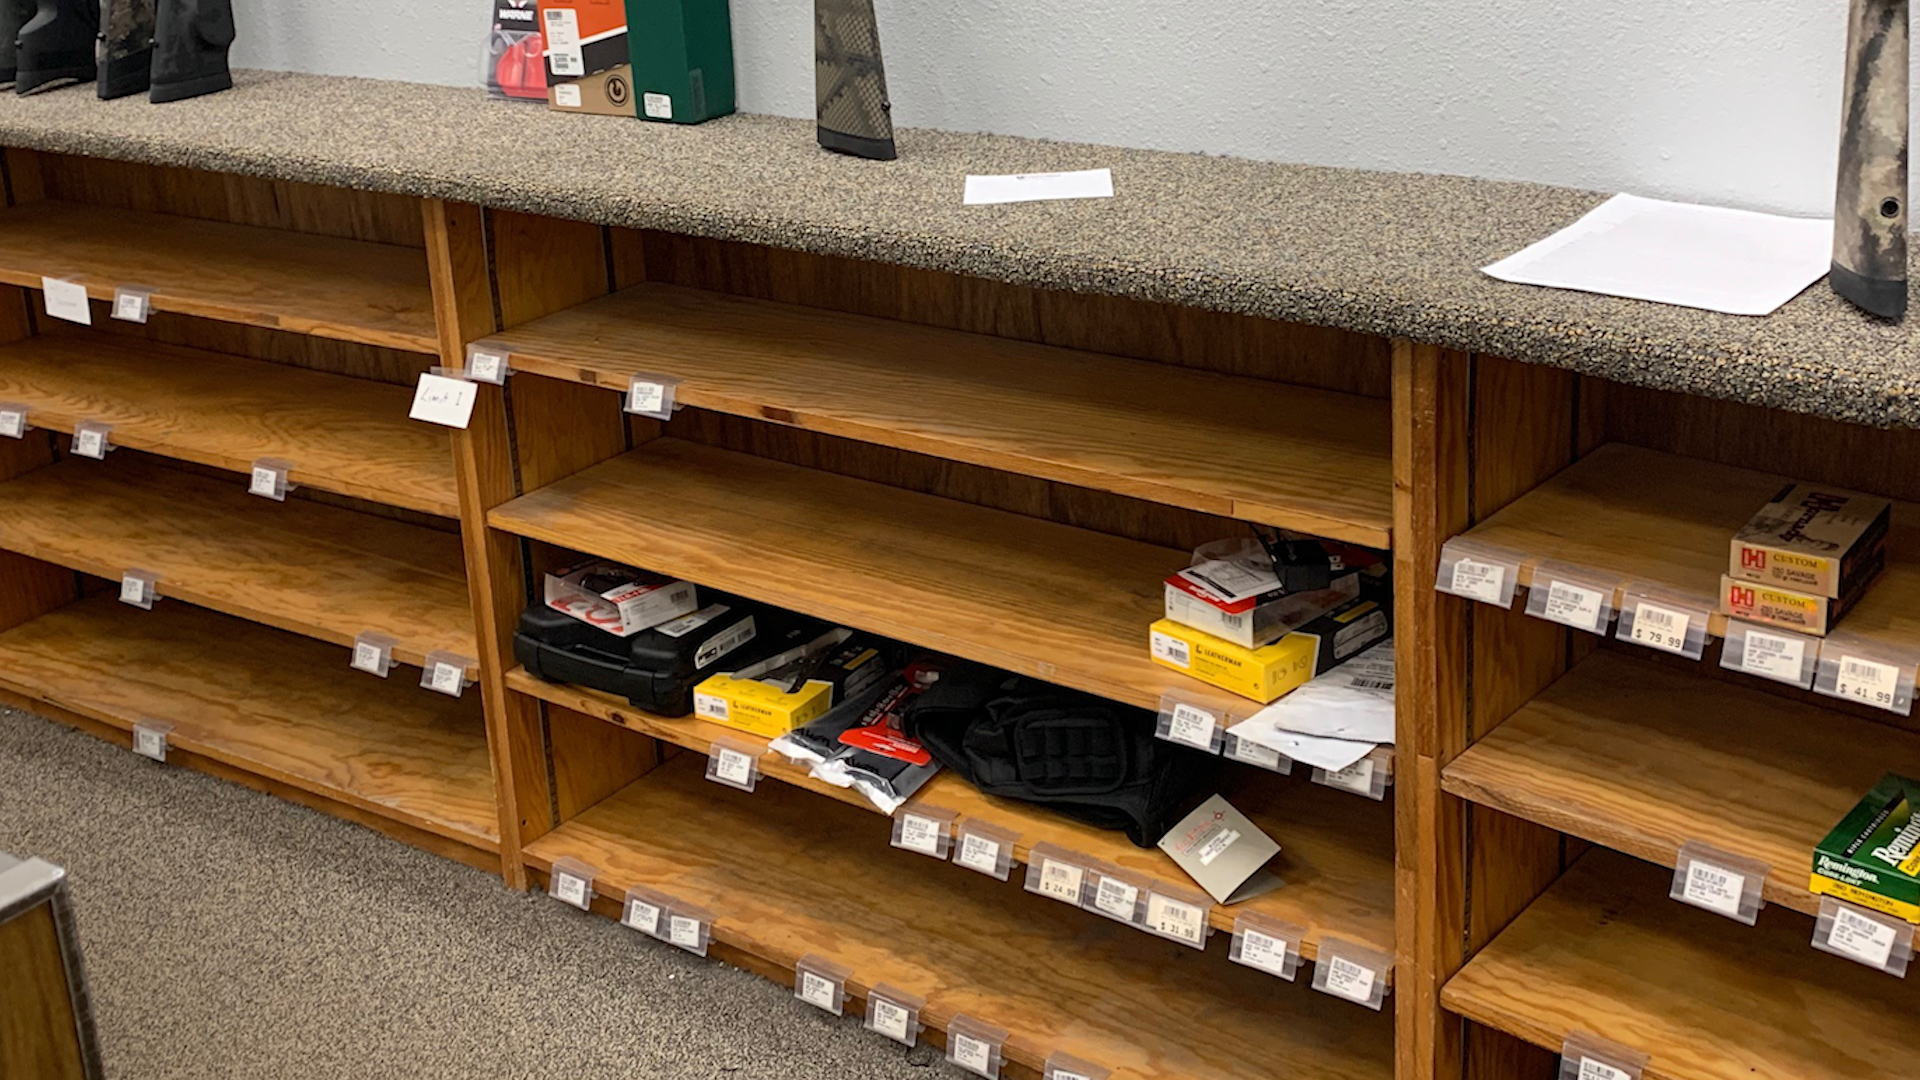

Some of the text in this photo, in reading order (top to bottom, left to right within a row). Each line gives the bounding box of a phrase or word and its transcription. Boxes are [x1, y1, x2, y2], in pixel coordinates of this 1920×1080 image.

[1773, 553, 1818, 569] CUSTOM
[1786, 568, 1816, 580] SAVAGE
[1761, 592, 1806, 608] CUSTOM
[1774, 607, 1804, 618] SAVAGE
[1649, 631, 1681, 648] 79.99
[1204, 649, 1242, 667] LEATHERMAN
[1854, 687, 1891, 704] 41.99
[740, 704, 772, 716] LEATHERMAN
[1817, 855, 1879, 885] Remington
[1053, 884, 1076, 898] 24.99
[1850, 888, 1894, 907] REMINGTON
